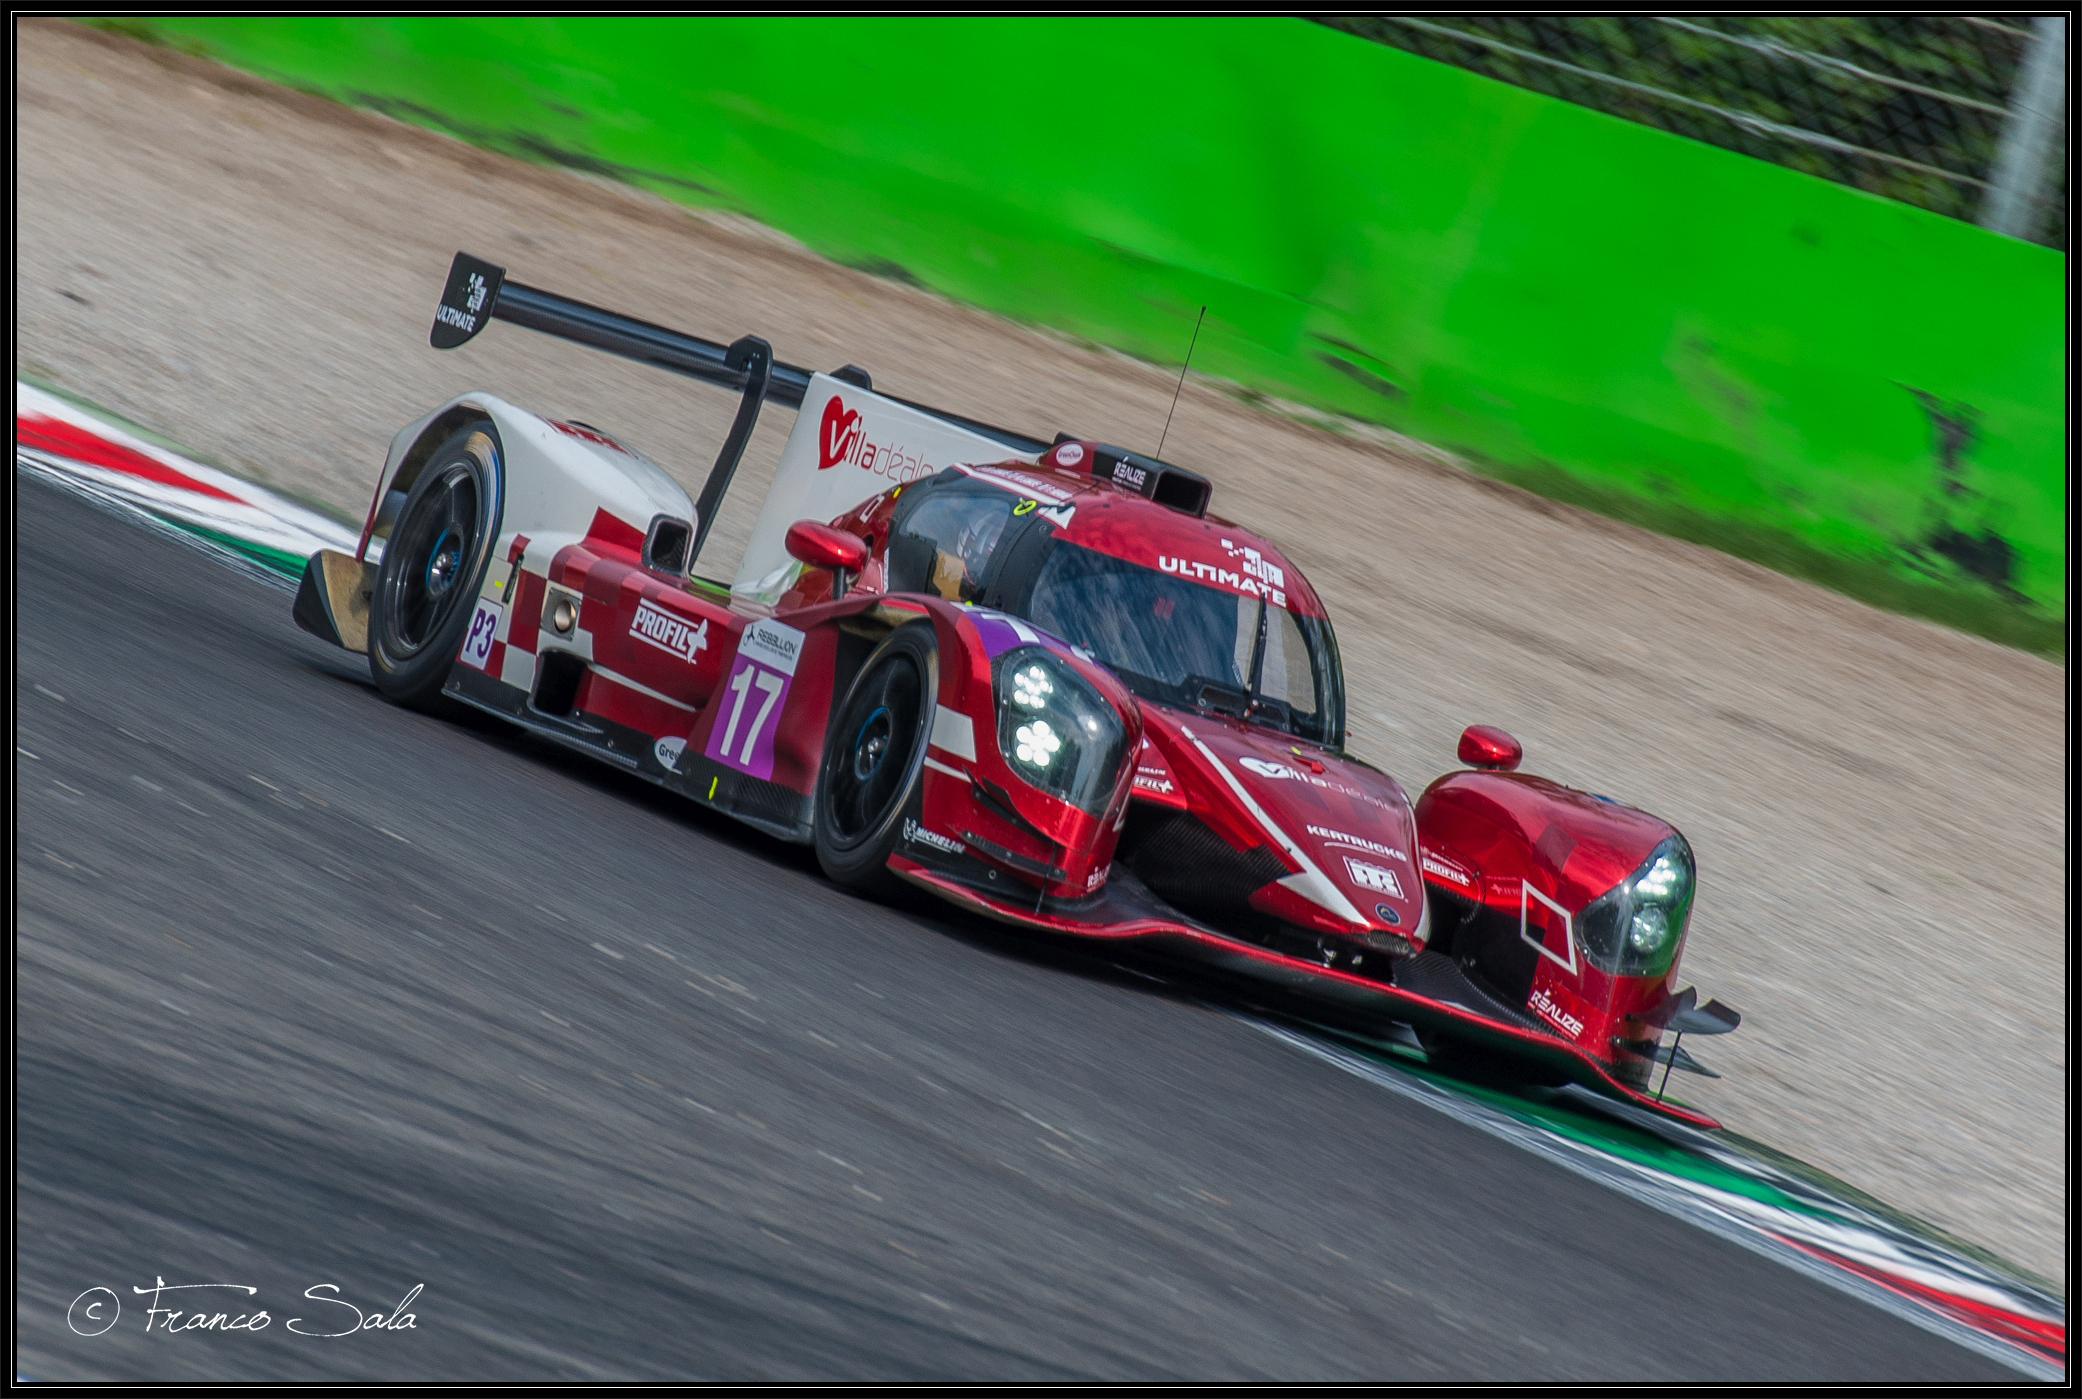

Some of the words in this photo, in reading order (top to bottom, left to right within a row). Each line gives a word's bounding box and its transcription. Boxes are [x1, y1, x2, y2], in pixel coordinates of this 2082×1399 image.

[436, 303, 476, 333] ULTIMATE
[1158, 555, 1287, 608] ULTIMATE
[465, 607, 497, 658] P3
[757, 628, 798, 655] REBELLION
[720, 663, 784, 766] 17
[1306, 824, 1407, 862] KERTRUCKS
[1530, 988, 1584, 1037] RÉALIZE
